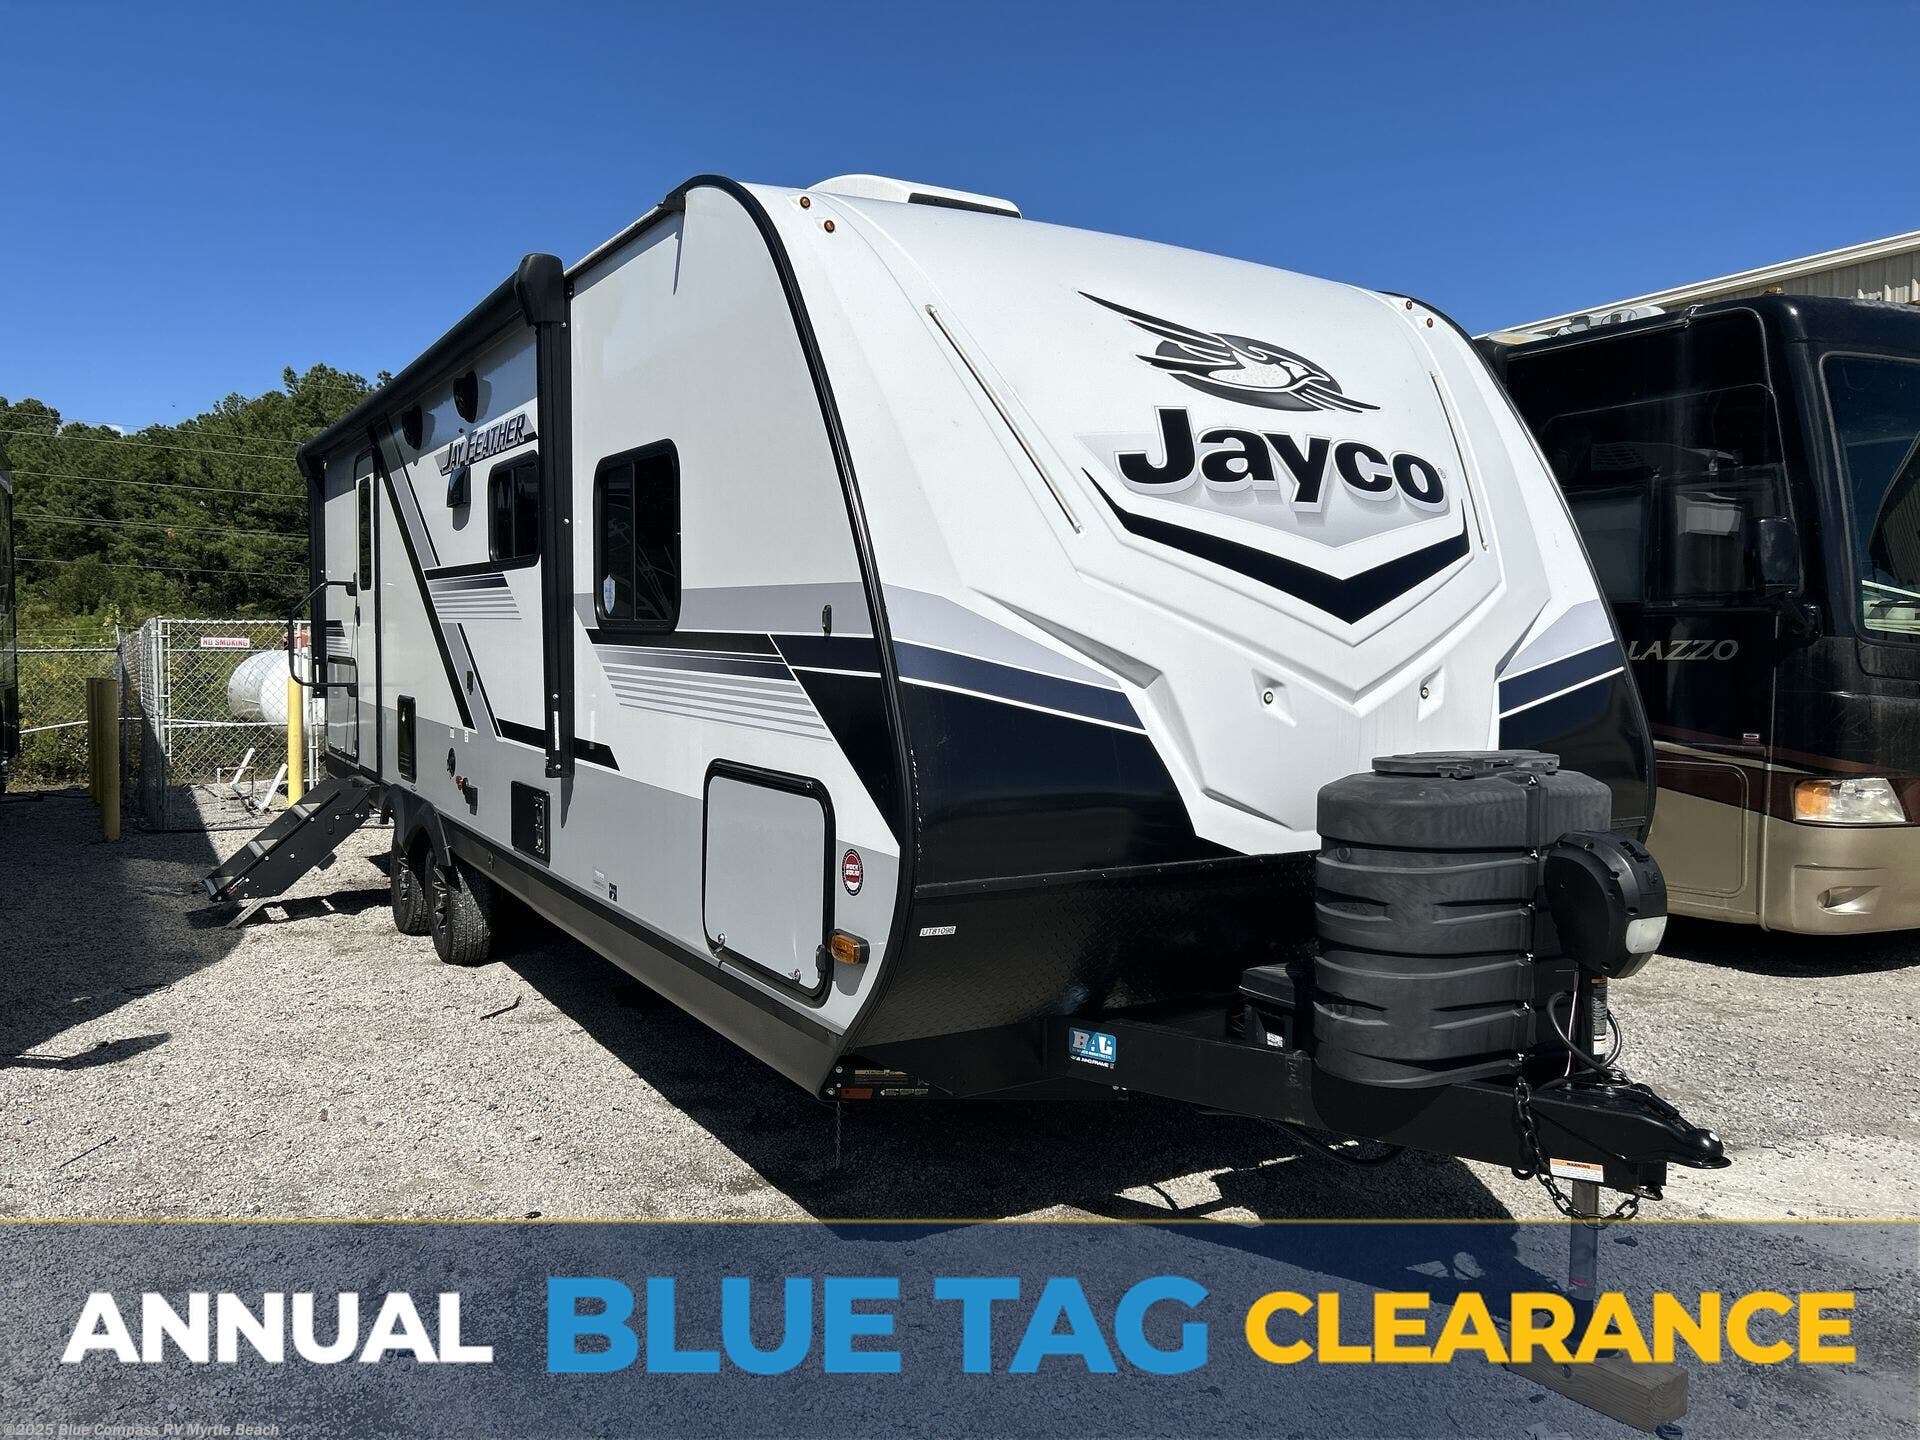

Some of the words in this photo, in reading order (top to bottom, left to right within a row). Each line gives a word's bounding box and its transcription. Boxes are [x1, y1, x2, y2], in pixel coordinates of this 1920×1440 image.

[464, 411, 526, 466] FEATHER
[1116, 407, 1446, 508] Jayco
[214, 639, 248, 647] SMOKING
[1628, 640, 1739, 660] LAZZO
